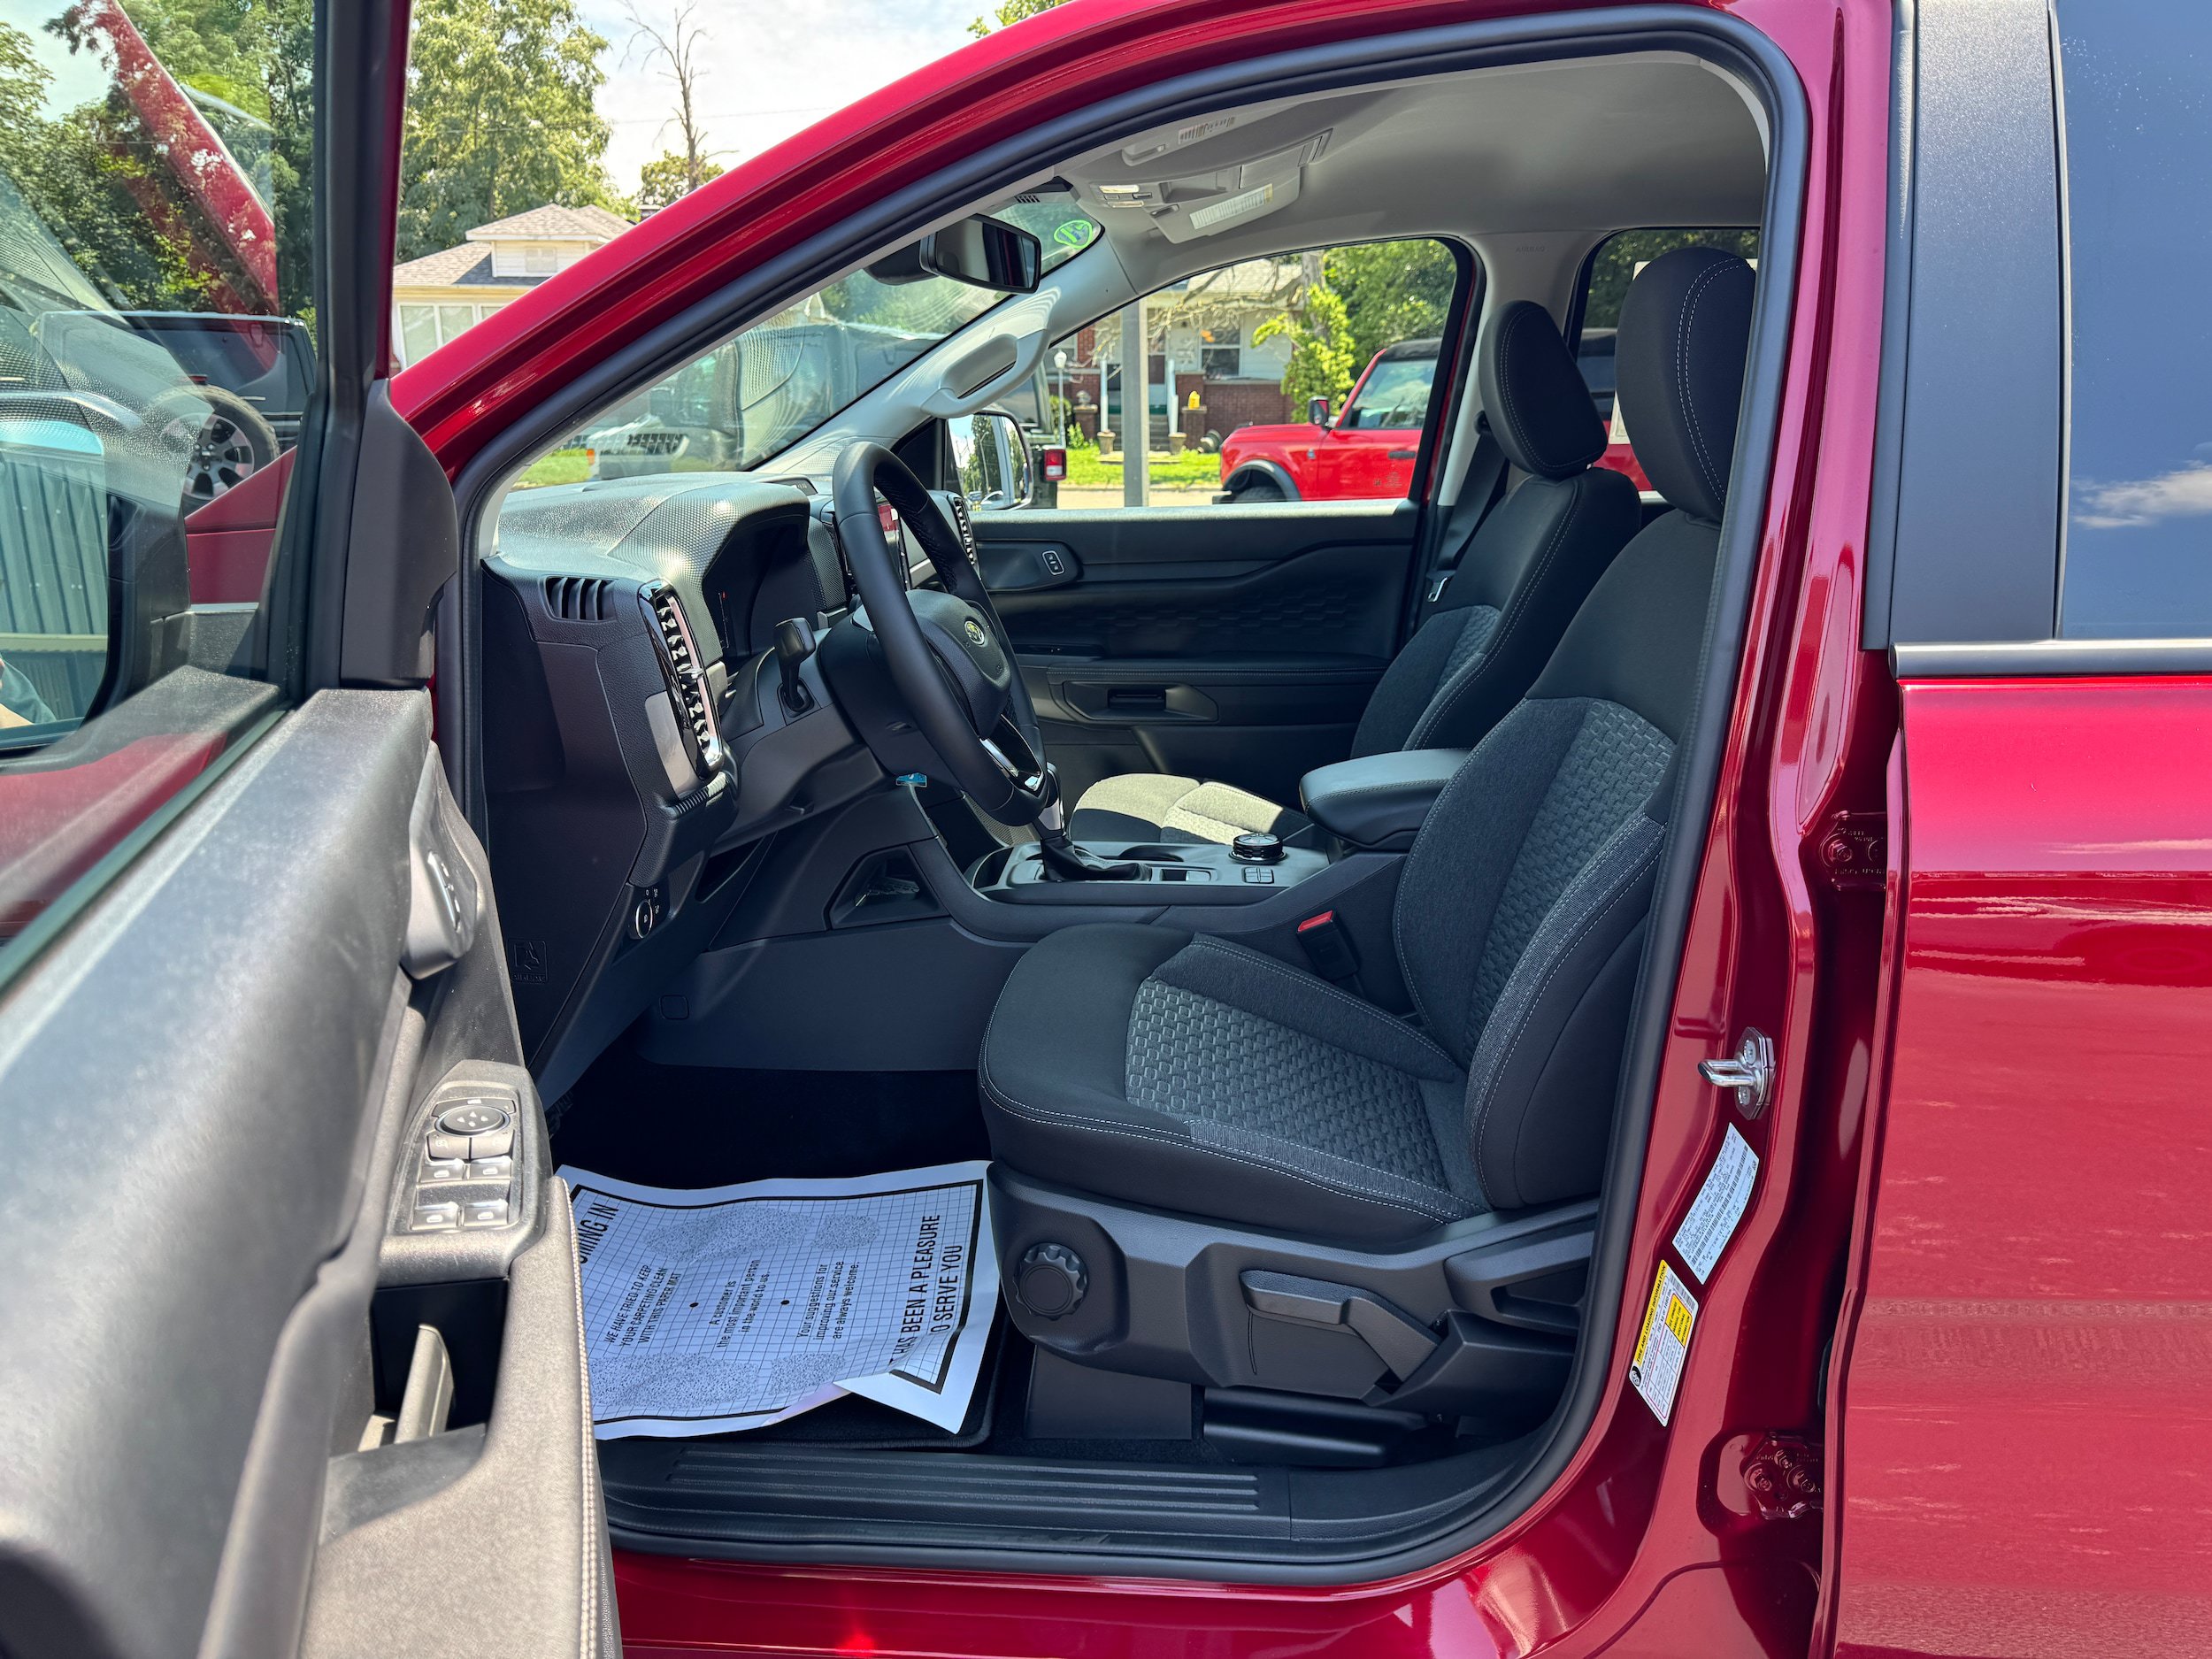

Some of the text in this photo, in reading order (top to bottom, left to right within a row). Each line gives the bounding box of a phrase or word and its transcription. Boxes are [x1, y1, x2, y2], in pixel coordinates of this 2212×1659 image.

[588, 1203, 618, 1219] IN
[892, 1215, 940, 1354] HAS BEEN A PLEASURE
[941, 1246, 962, 1271] YOU
[604, 1265, 651, 1343] WE HAVE TRIED TO KEEP
[619, 1268, 667, 1346] YOUR CARPETING CLEAN
[638, 1272, 681, 1343] WITH THIS PAPER MAT
[713, 1289, 733, 1317] customer
[717, 1260, 760, 1347] the most important person
[742, 1313, 756, 1323] the
[749, 1294, 763, 1310] world
[797, 1264, 827, 1338] Your suggestions for
[813, 1262, 844, 1340] improving our service
[833, 1262, 859, 1339] are always welcome.
[933, 1276, 957, 1321] SERVE
[1645, 1309, 1654, 1333] LOADING
[1652, 1265, 1666, 1308] INFORMATION
